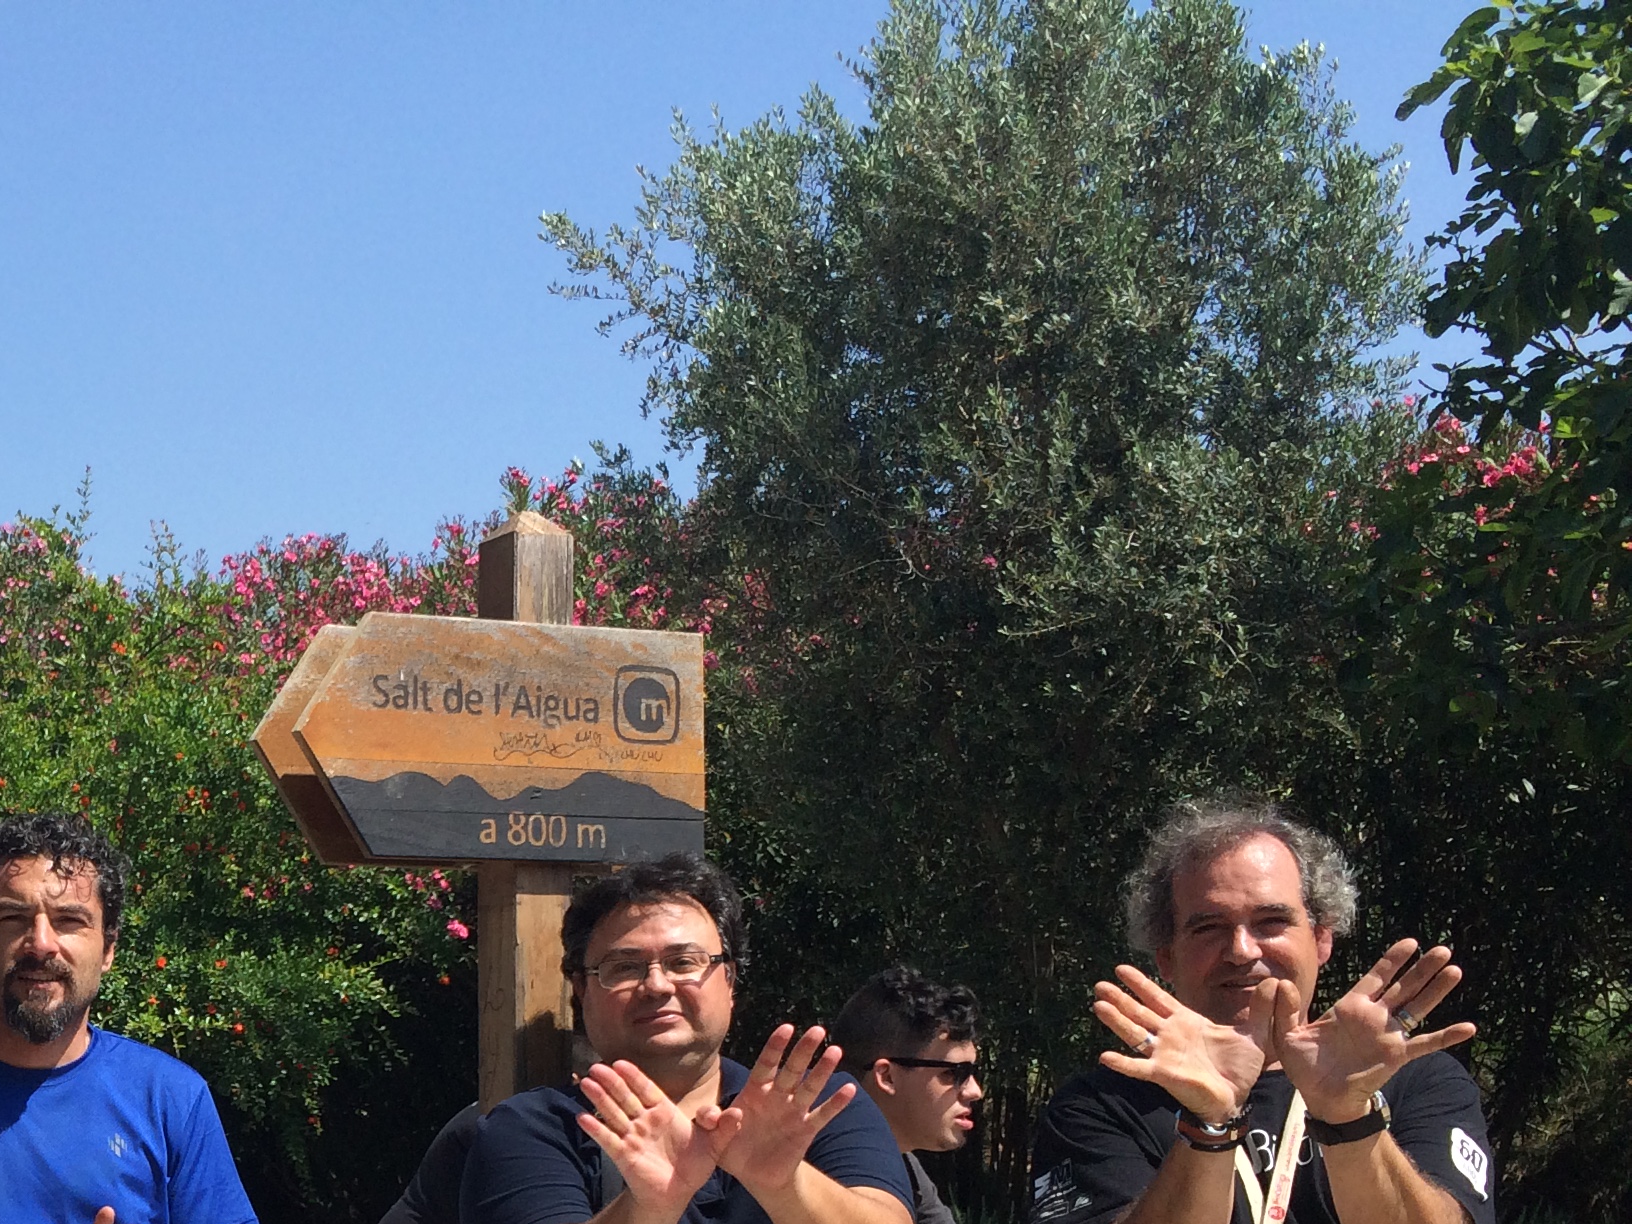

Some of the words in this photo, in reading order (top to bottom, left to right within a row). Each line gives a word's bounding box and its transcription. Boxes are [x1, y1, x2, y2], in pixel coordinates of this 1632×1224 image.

[372, 674, 433, 711] Salt
[443, 678, 484, 716] de
[493, 681, 599, 729] l'Aigua
[479, 818, 497, 844] a
[507, 811, 567, 847] 800
[577, 823, 606, 849] m
